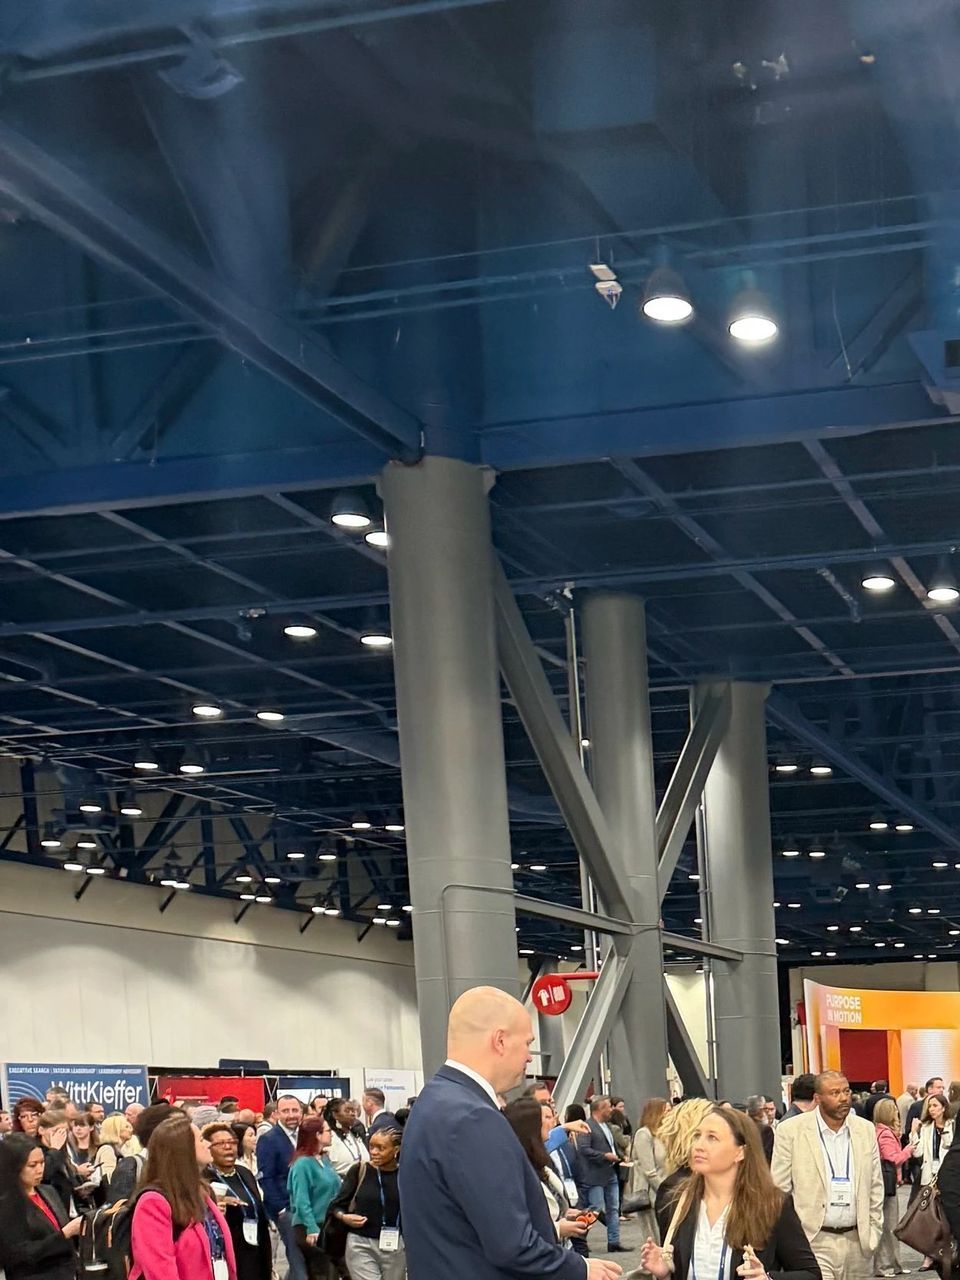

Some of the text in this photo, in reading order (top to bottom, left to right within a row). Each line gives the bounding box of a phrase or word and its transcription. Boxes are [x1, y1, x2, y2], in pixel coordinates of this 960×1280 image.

[826, 994, 862, 1010] PURPOSE
[834, 1010, 862, 1024] MOTION
[51, 1079, 143, 1110] WittKieffer
